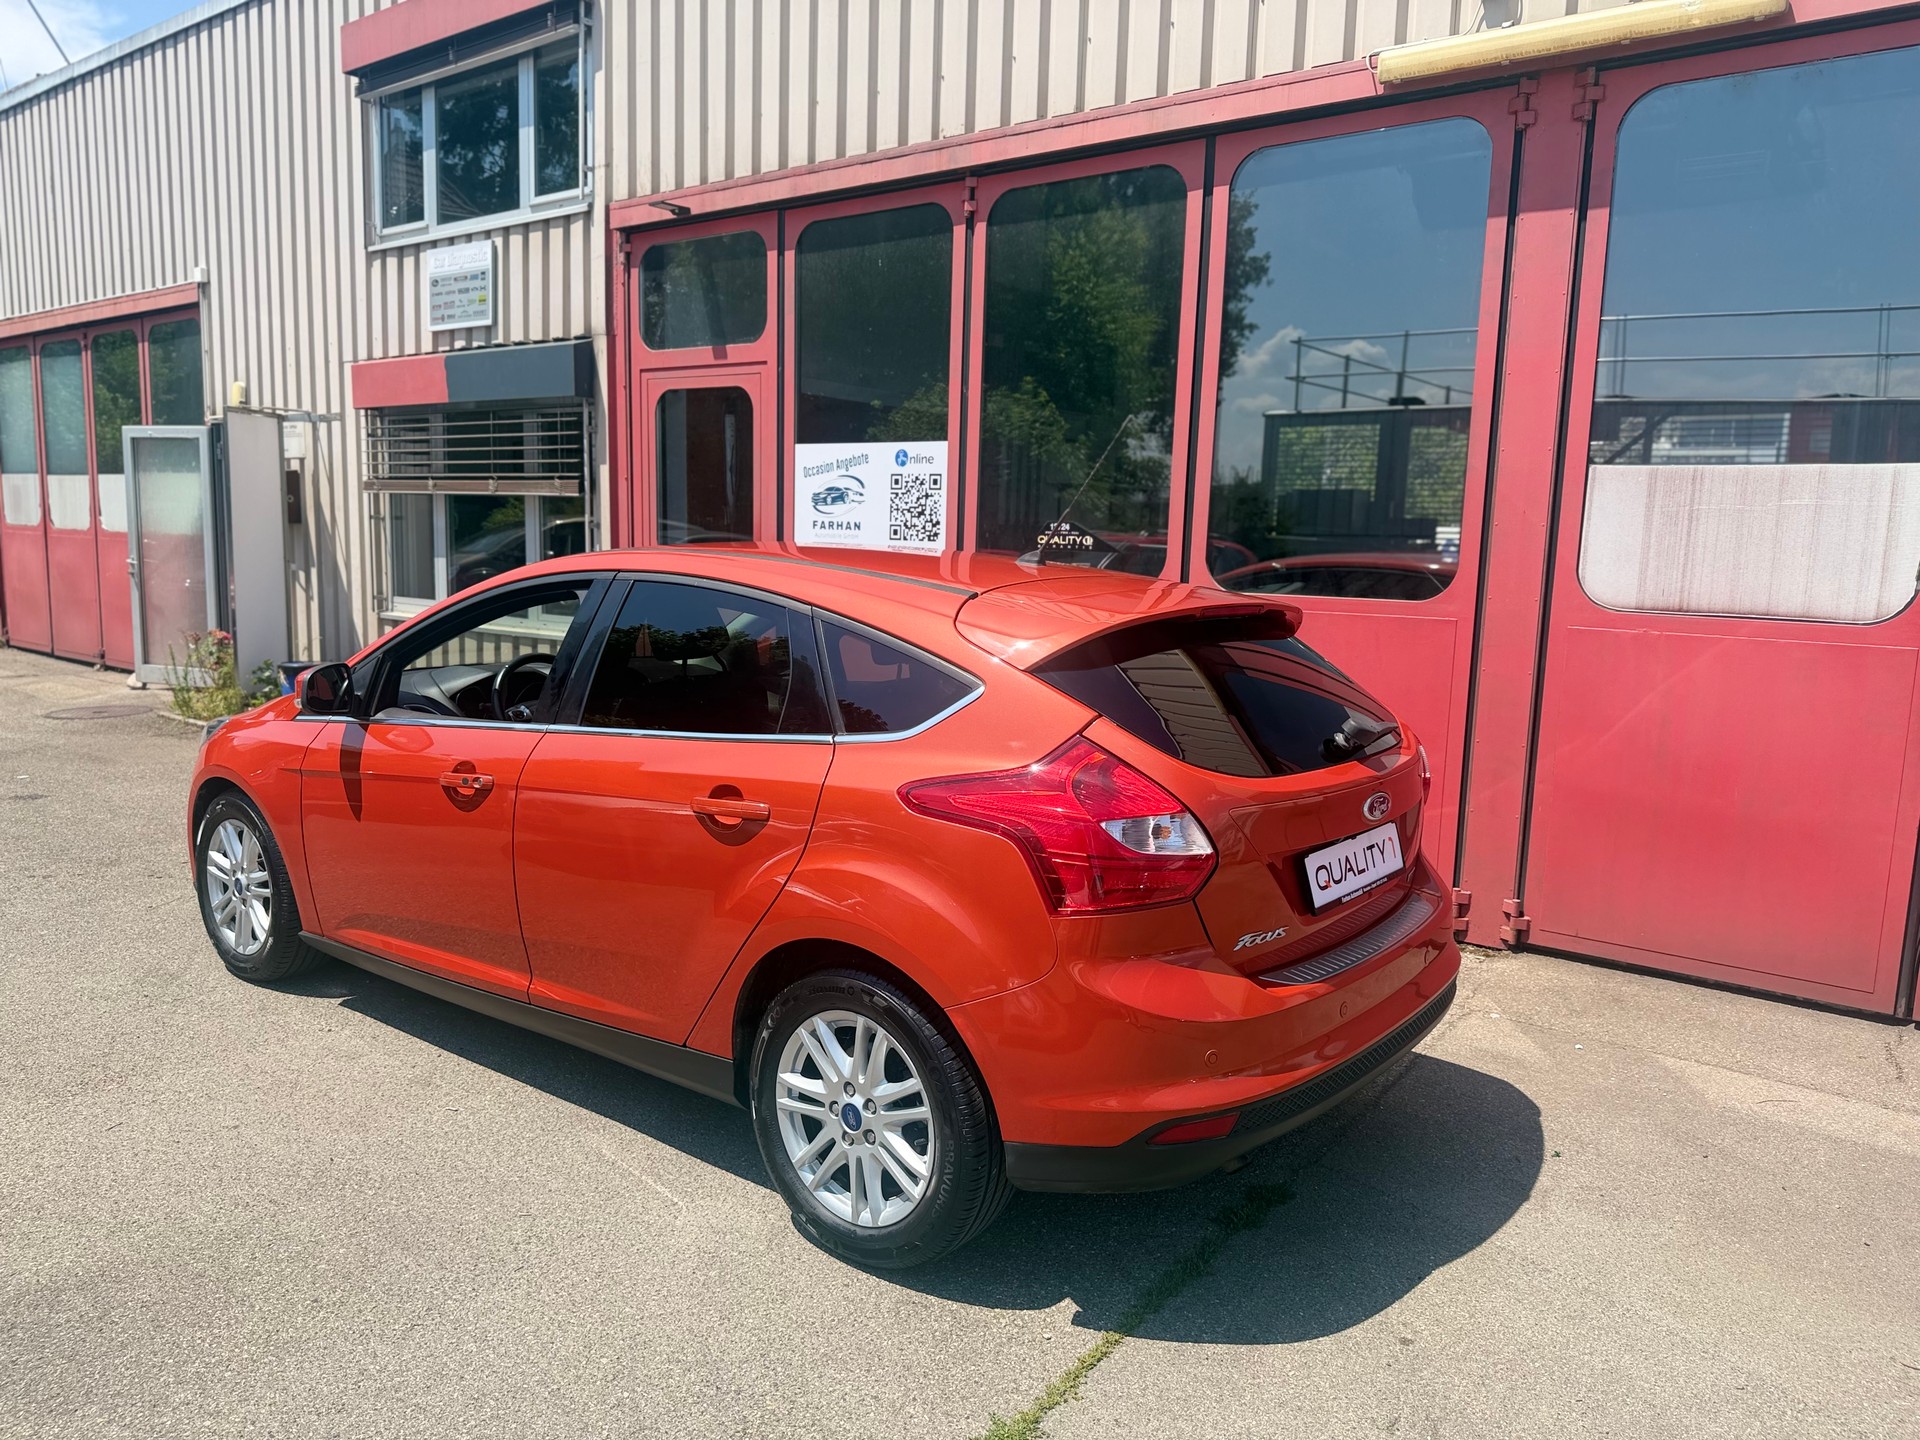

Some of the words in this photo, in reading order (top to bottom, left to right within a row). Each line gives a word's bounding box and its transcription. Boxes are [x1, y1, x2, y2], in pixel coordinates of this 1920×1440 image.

[803, 463, 834, 478] Occasion
[836, 453, 869, 472] Angebote
[812, 520, 861, 531] FARHAN
[1315, 839, 1386, 891] QUALITY
[1233, 927, 1289, 951] Focus
